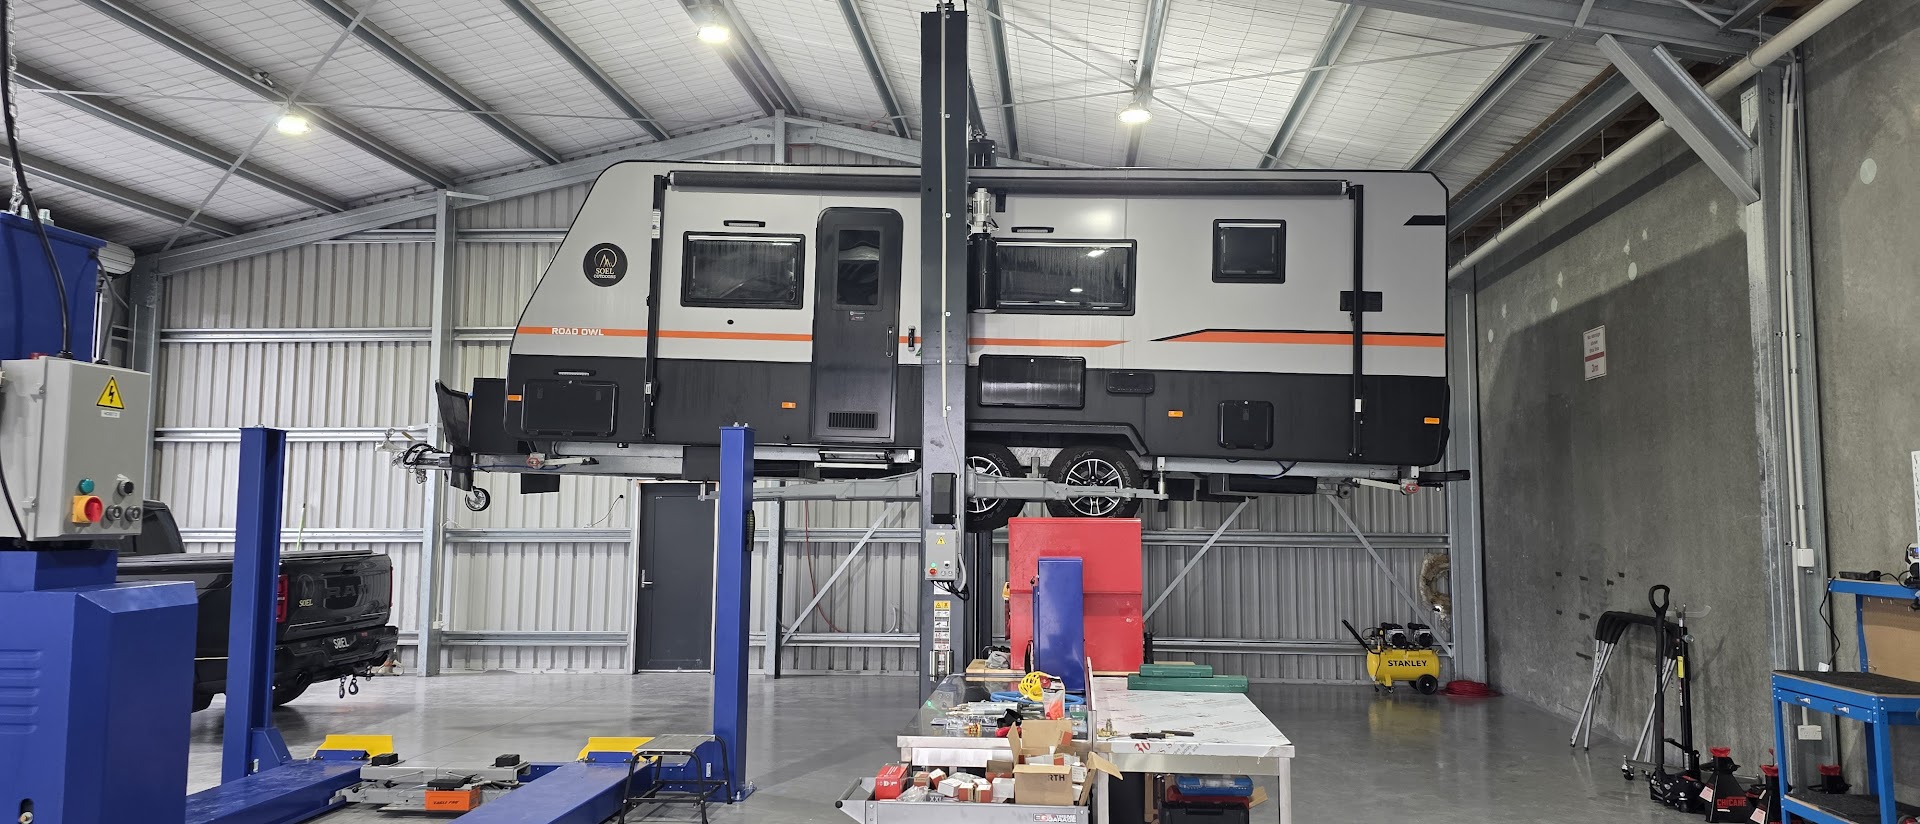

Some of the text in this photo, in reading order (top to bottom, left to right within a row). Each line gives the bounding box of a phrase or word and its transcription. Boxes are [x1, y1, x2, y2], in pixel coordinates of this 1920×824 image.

[595, 267, 615, 275] SOEL
[551, 327, 605, 336] ROAD OWL
[298, 598, 313, 607] SOEL
[1716, 799, 1747, 807] CHICANE
